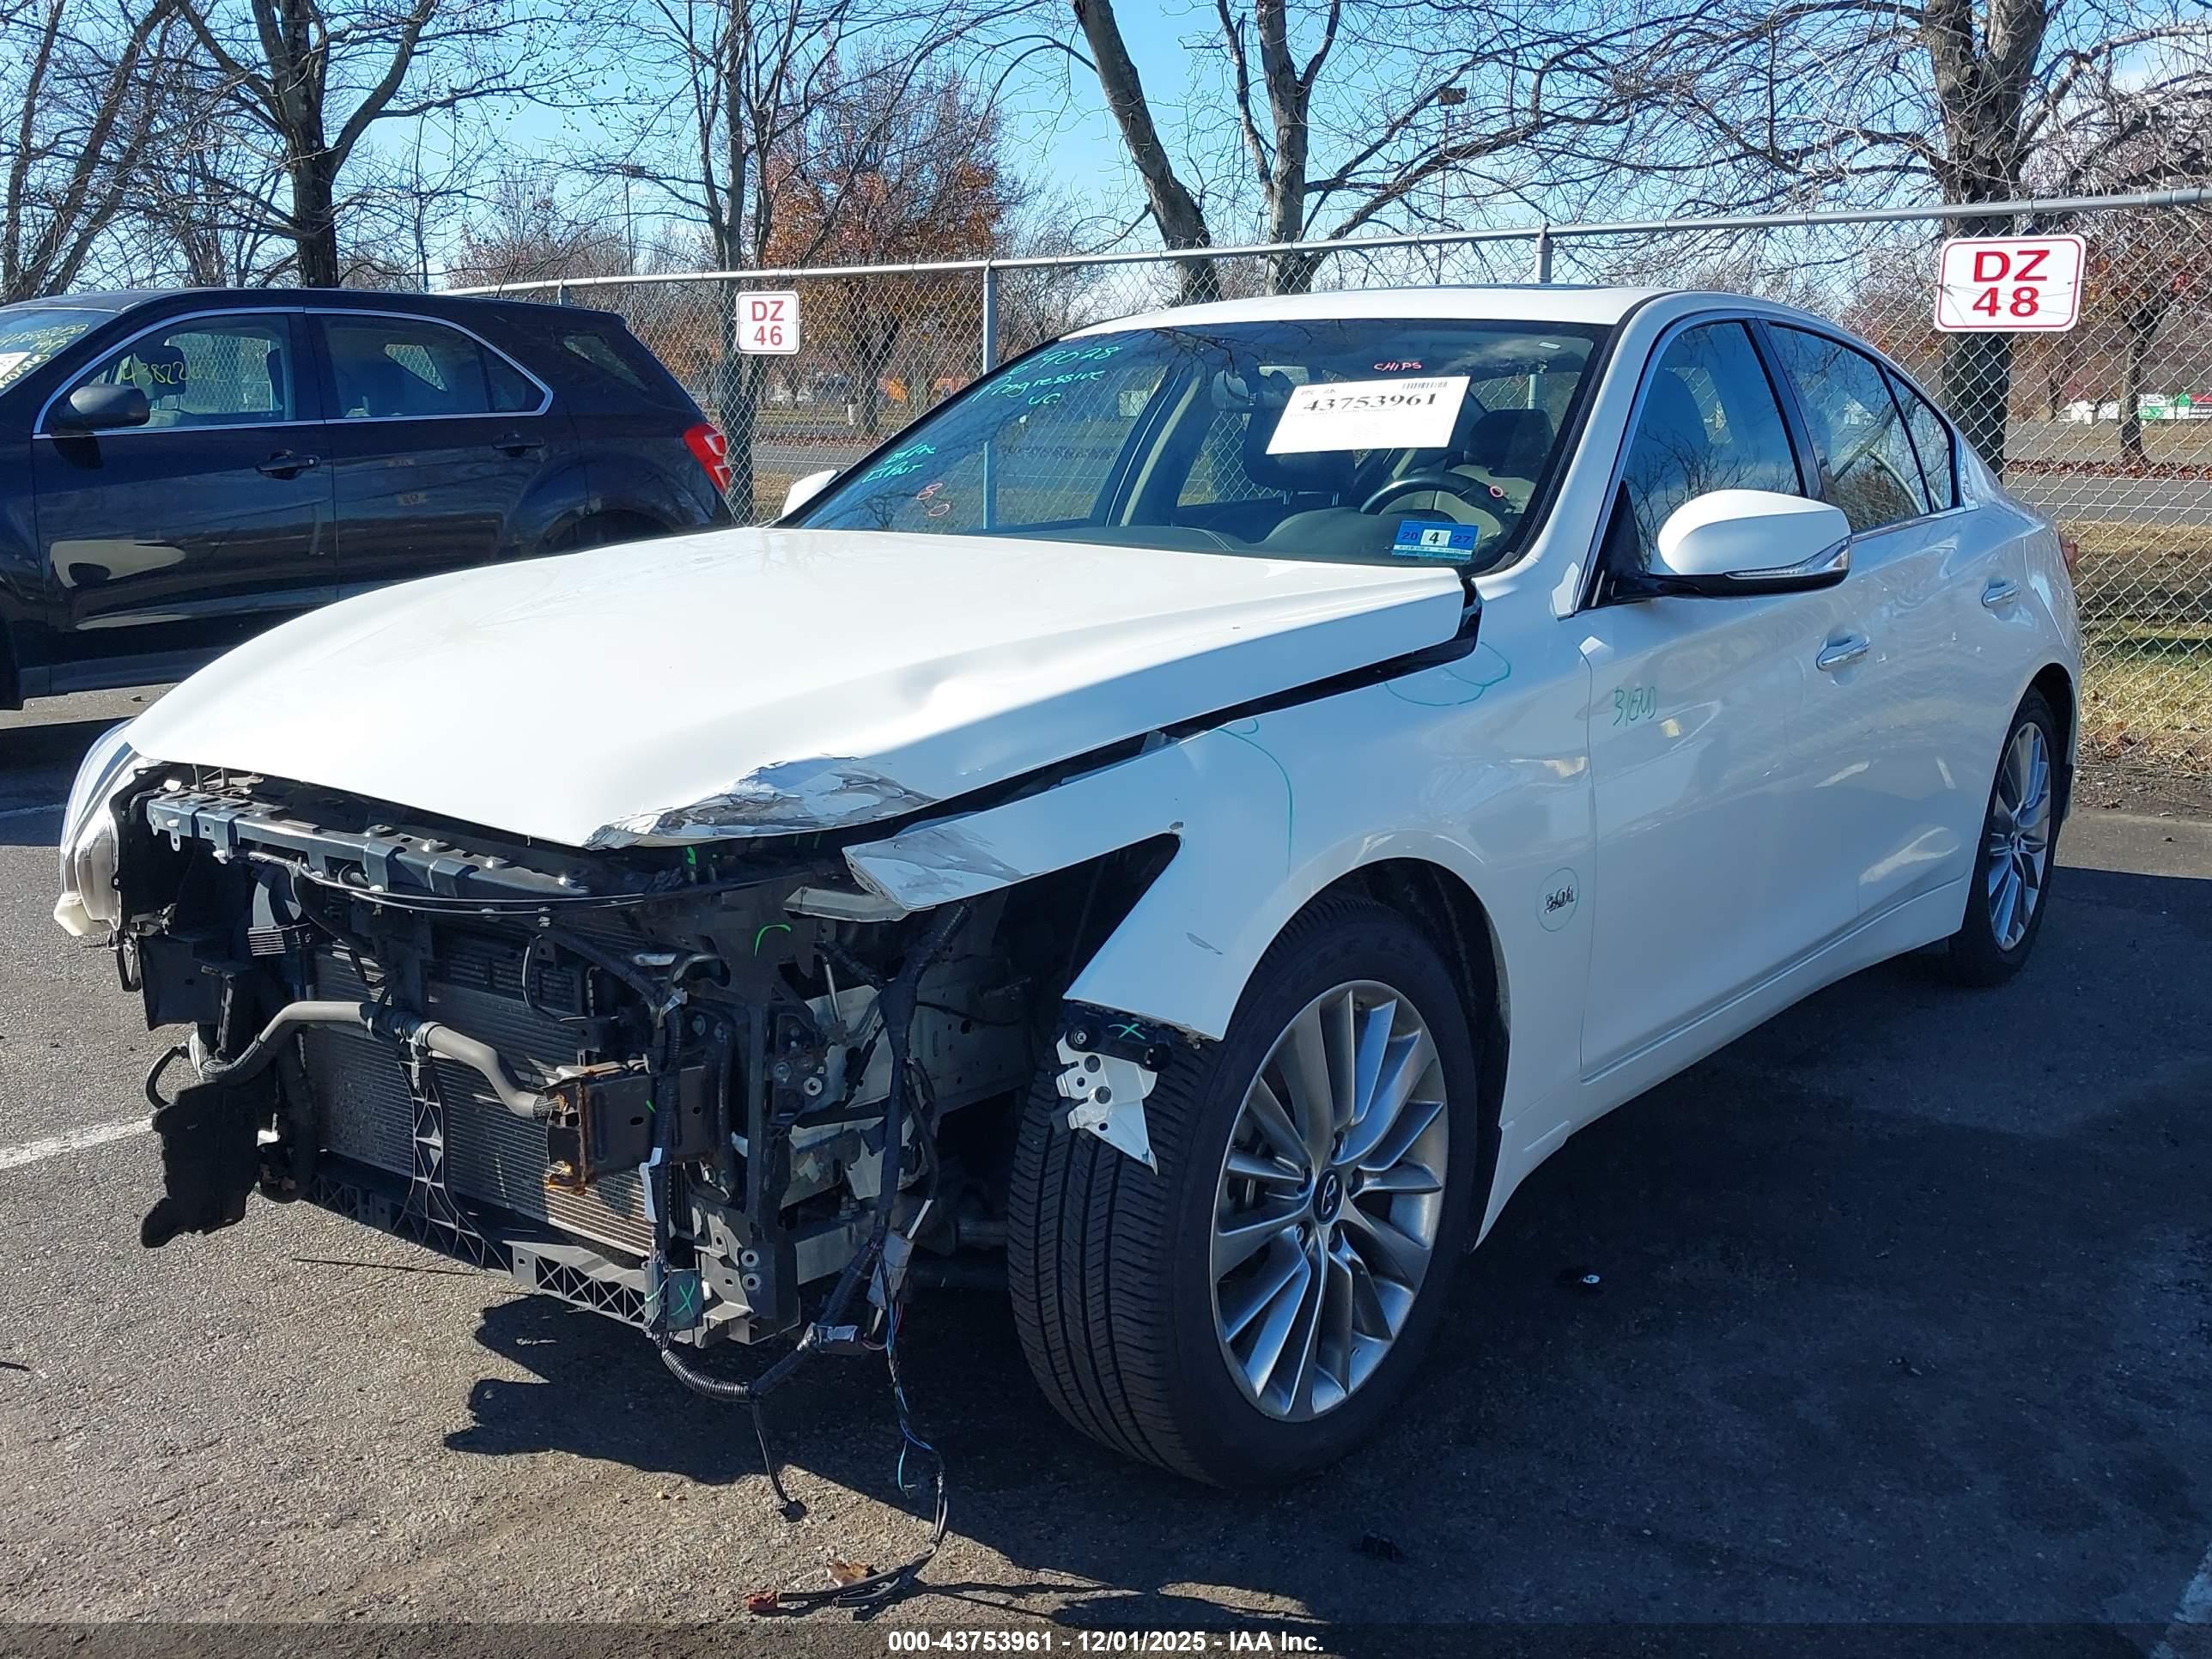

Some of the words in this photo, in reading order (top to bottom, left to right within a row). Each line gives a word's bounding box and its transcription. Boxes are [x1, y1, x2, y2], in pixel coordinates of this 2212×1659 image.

[1973, 250, 2050, 283] DZ
[751, 301, 785, 322] DZ
[1972, 286, 2039, 318] 48
[753, 325, 783, 346] 46
[1373, 362, 1422, 372] CHIPS
[1302, 392, 1437, 412] 43753961
[1401, 532, 1419, 541] 20
[1428, 532, 1440, 544] 4
[1452, 535, 1472, 544] 27
